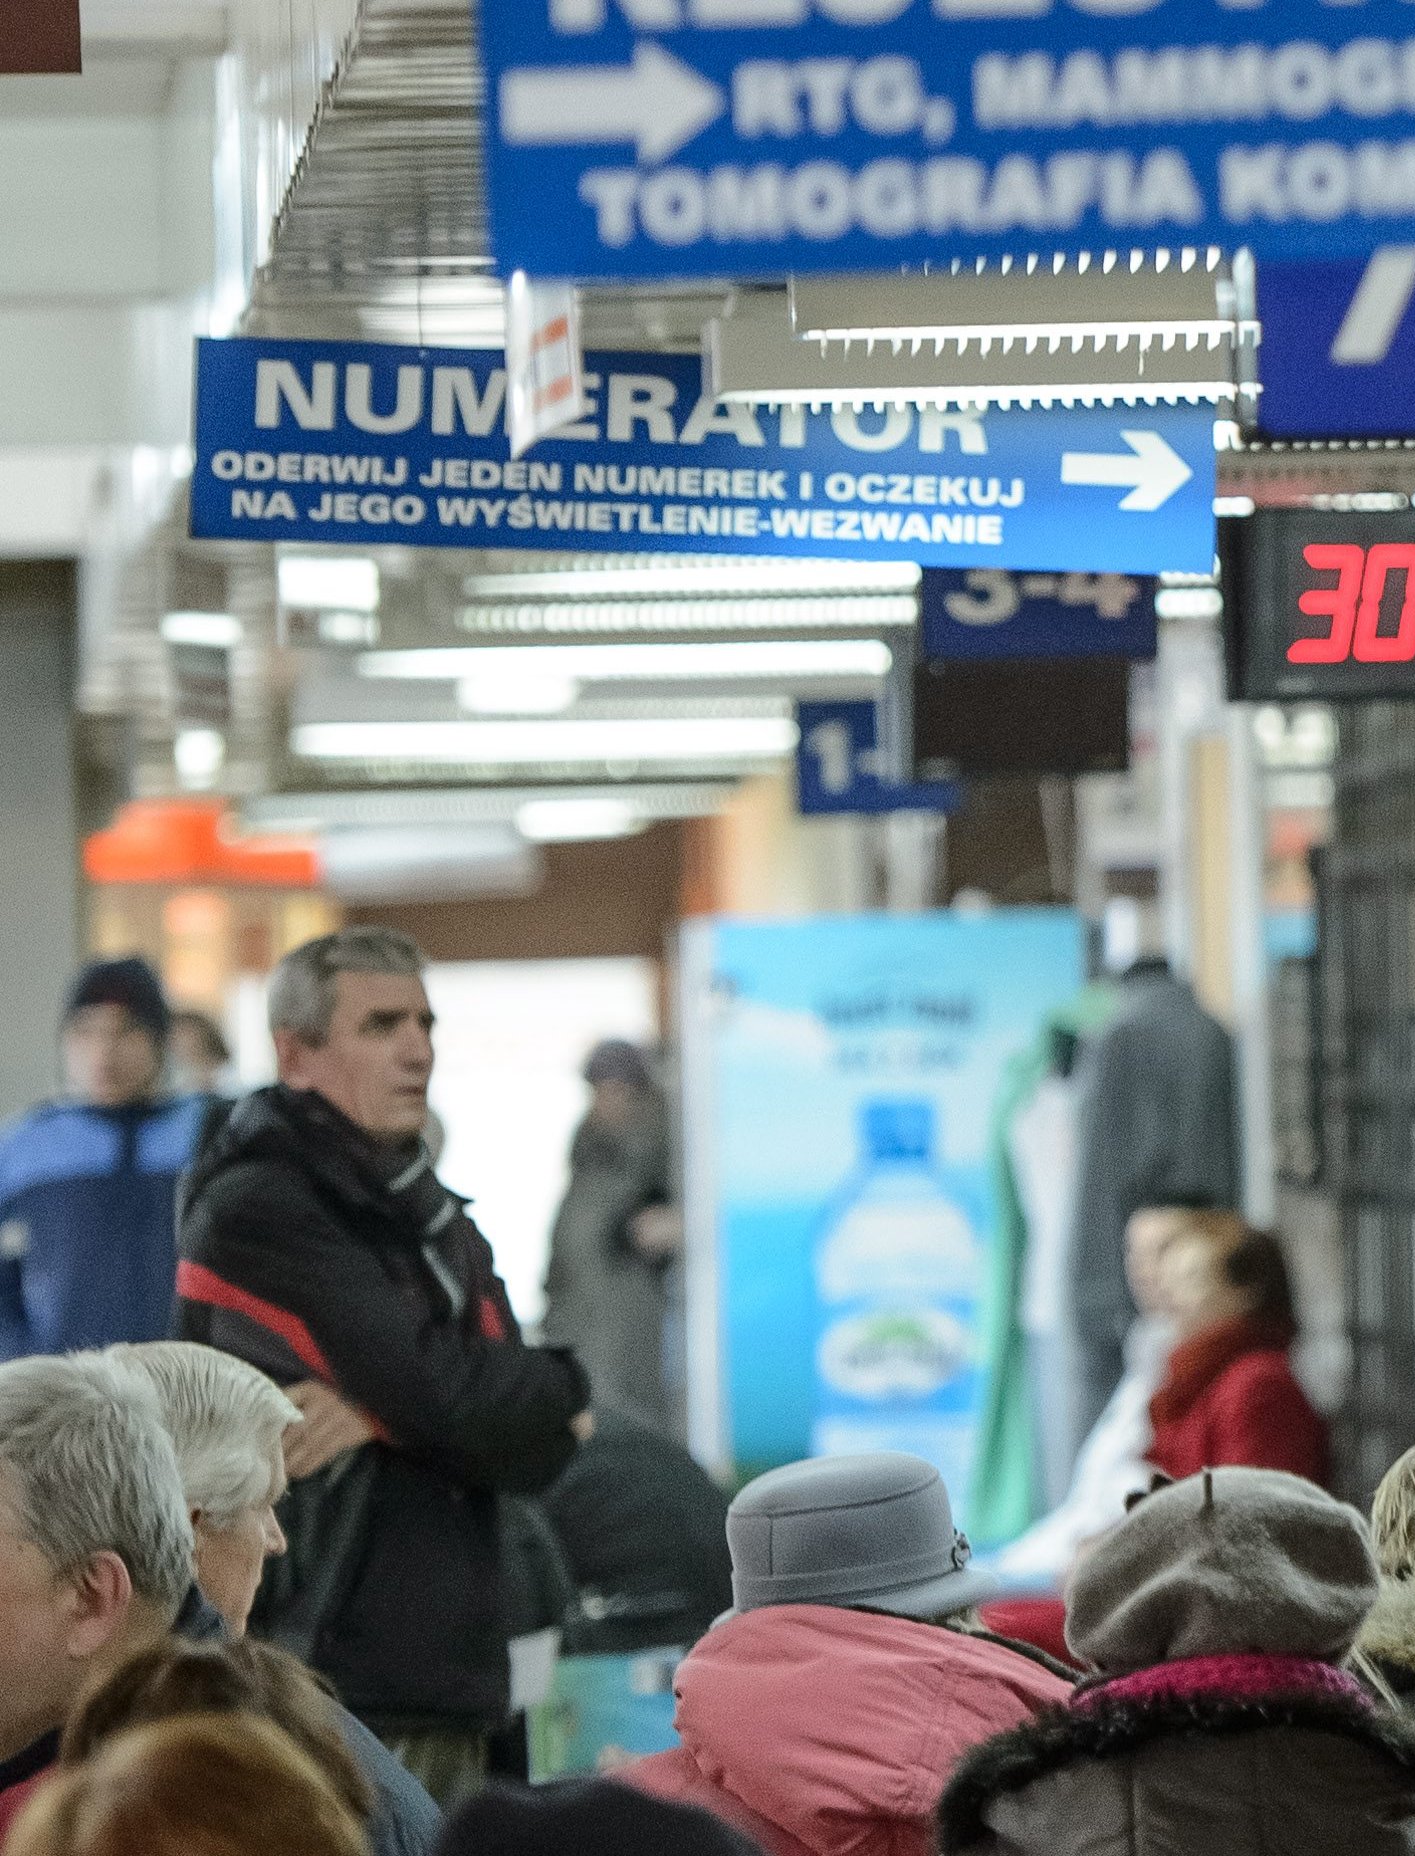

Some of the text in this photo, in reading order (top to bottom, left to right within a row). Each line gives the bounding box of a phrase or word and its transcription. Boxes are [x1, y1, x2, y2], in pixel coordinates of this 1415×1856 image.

[732, 52, 957, 144] RTG,
[579, 146, 1203, 248] TOMOGRAFIA
[211, 449, 1025, 509] ODERWIJ JEDEN NUMEREK I OCZEKUJ
[230, 488, 1003, 546] NA JEGO WYŚWIETLENIE-WEZWANIE
